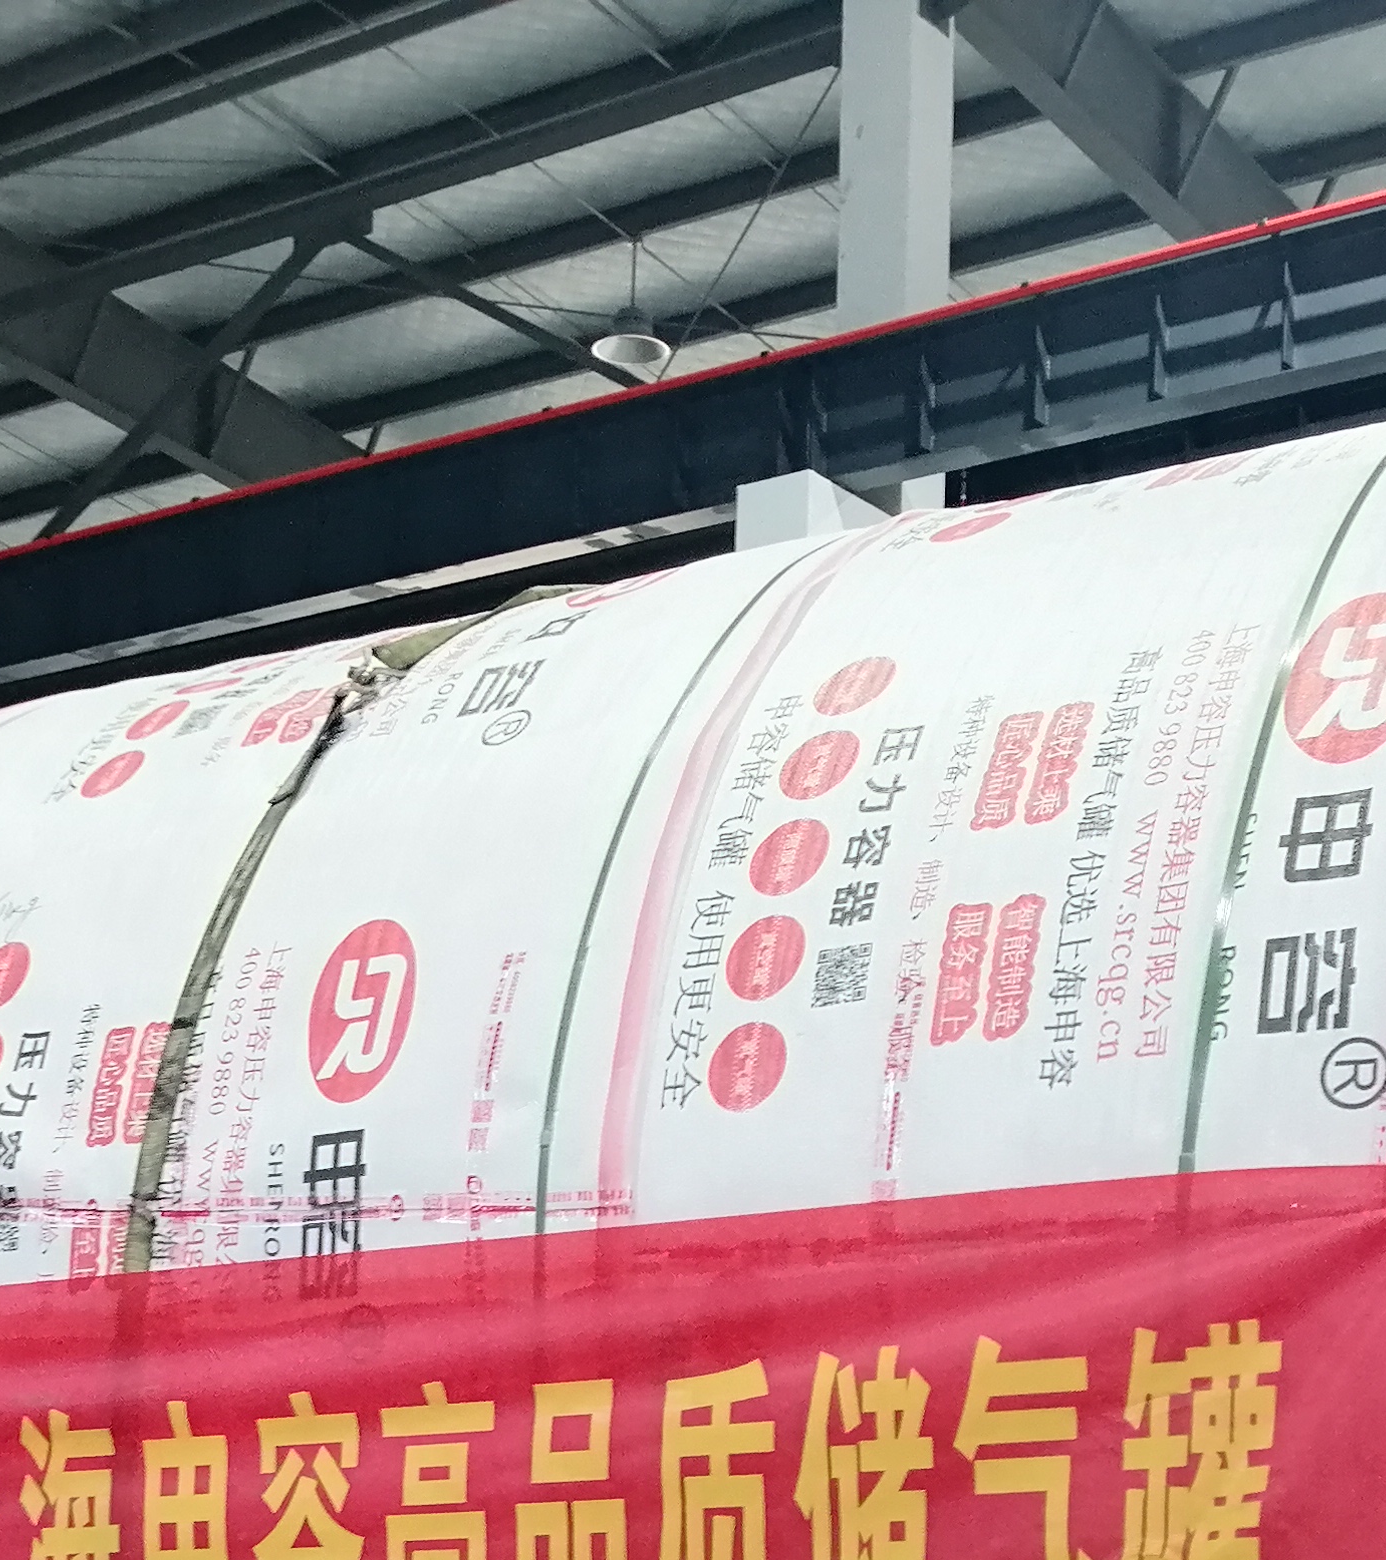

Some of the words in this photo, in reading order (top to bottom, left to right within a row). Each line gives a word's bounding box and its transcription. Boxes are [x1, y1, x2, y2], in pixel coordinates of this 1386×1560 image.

[421, 671, 463, 725] RONG
[1165, 672, 1189, 714] 823
[1185, 630, 1215, 666] 400
[707, 695, 802, 869] 申容储气罐
[977, 715, 1043, 825] 匠心品质
[1032, 704, 1090, 817] 选材上乘
[1075, 646, 1163, 842] 高品质储气罐
[1143, 724, 1176, 787] 9880
[829, 725, 924, 928] 压力容器
[1133, 623, 1261, 1060] 上海申容压力容器集团有限公司
[236, 946, 261, 991] 400
[988, 899, 1041, 1031] 智能制造
[1037, 850, 1107, 1089] 优选上海申容
[1095, 809, 1159, 1063] www.srcqg.cn
[1258, 788, 1376, 1034] 申容
[221, 999, 244, 1043] 823
[661, 891, 734, 1108] 使用更安全
[932, 909, 989, 1038] 服务至上
[1211, 944, 1237, 1042] RONG
[211, 1051, 233, 1115] 9880
